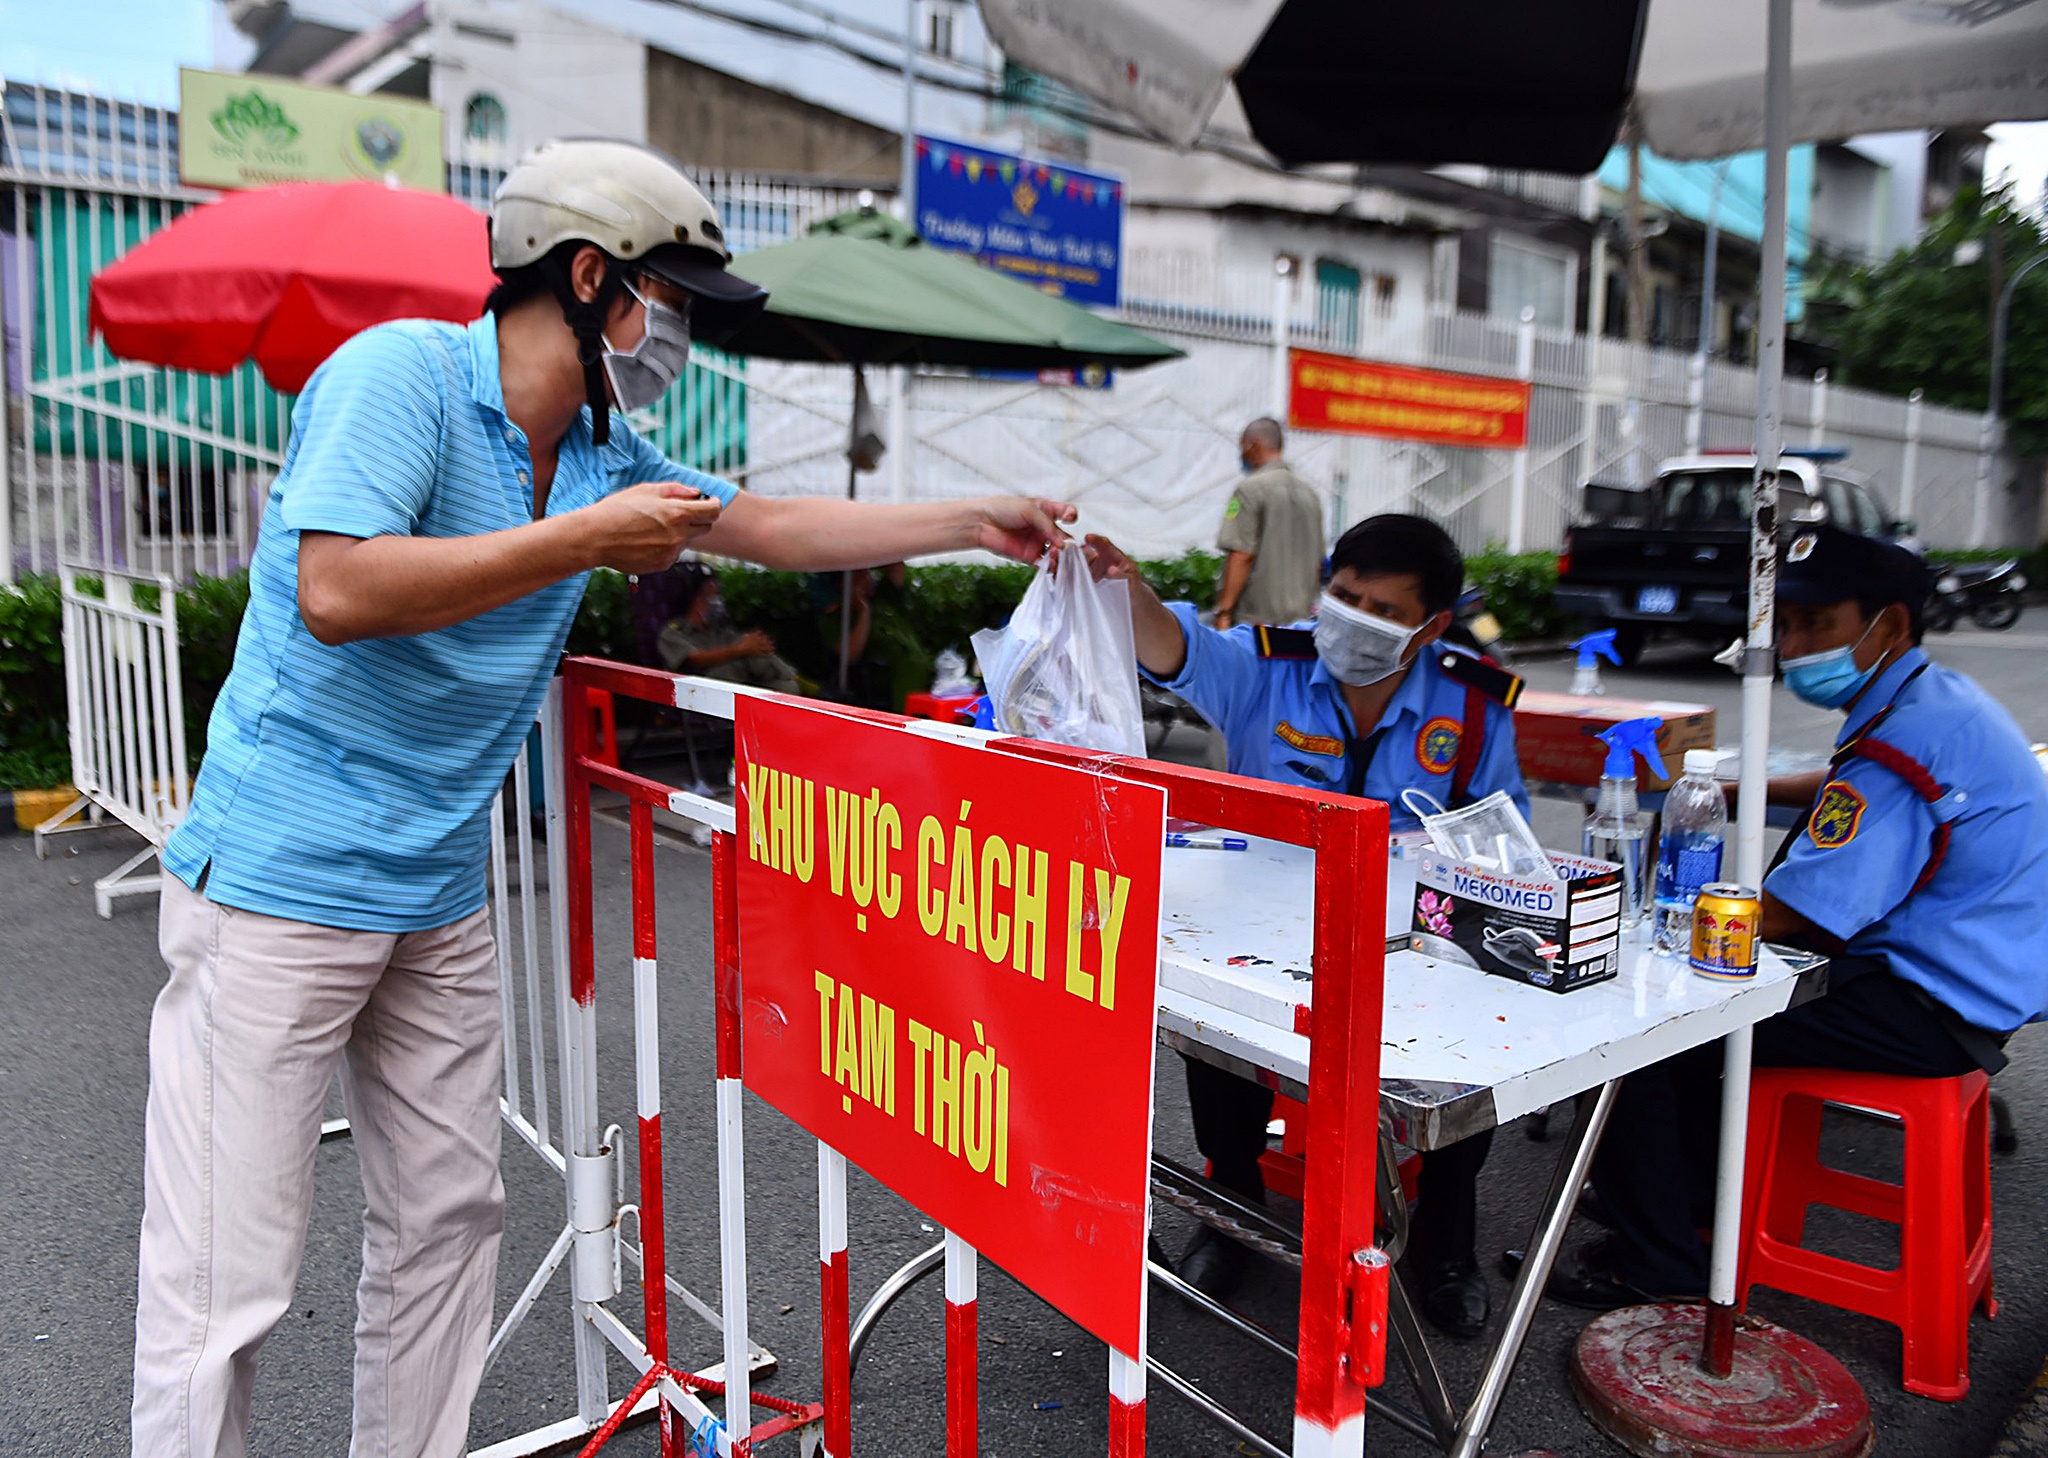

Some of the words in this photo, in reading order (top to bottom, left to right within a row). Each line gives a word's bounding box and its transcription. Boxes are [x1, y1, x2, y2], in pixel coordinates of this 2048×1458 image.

[749, 763, 814, 883] KHU
[826, 787, 902, 932] VỰC
[917, 800, 1049, 982] CÁCH
[1065, 862, 1131, 1011] LY
[1453, 874, 1554, 912] MEKOMED
[1516, 881, 1534, 890] CAO
[1535, 882, 1554, 892] CẤP
[815, 970, 895, 1117] TẠM
[909, 1019, 1009, 1187] THỜI
